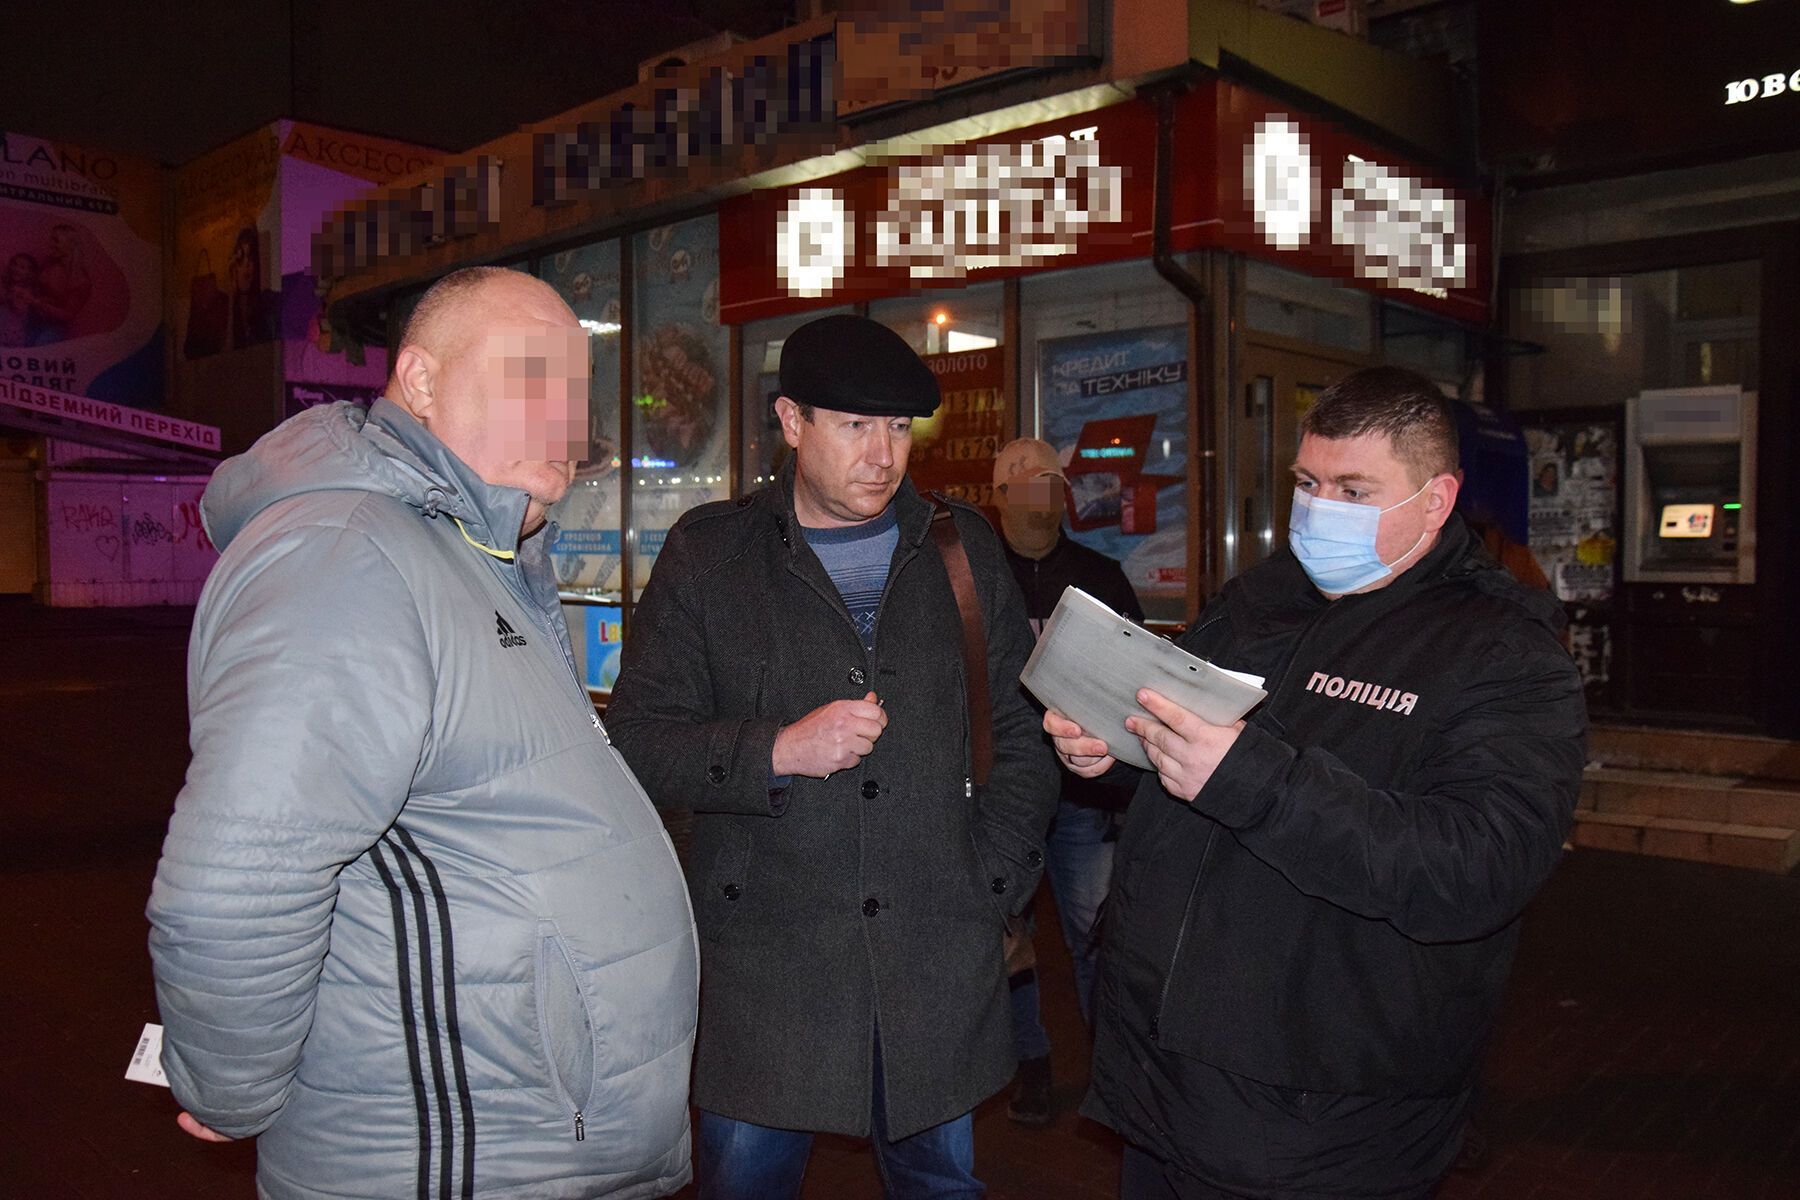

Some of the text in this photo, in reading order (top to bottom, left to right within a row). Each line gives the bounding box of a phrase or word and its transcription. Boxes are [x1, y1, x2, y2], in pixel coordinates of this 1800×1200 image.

[284, 133, 433, 176] АКСЕС
[0, 355, 76, 375] ОВИЙ
[1083, 364, 1181, 395] ТЕХНІКУ
[131, 414, 214, 446] ПЕРЕХІД
[949, 437, 996, 460] 1679
[499, 632, 527, 649] adidas
[600, 621, 622, 643] La
[1305, 671, 1418, 716] ПОЛІЦІЯ
